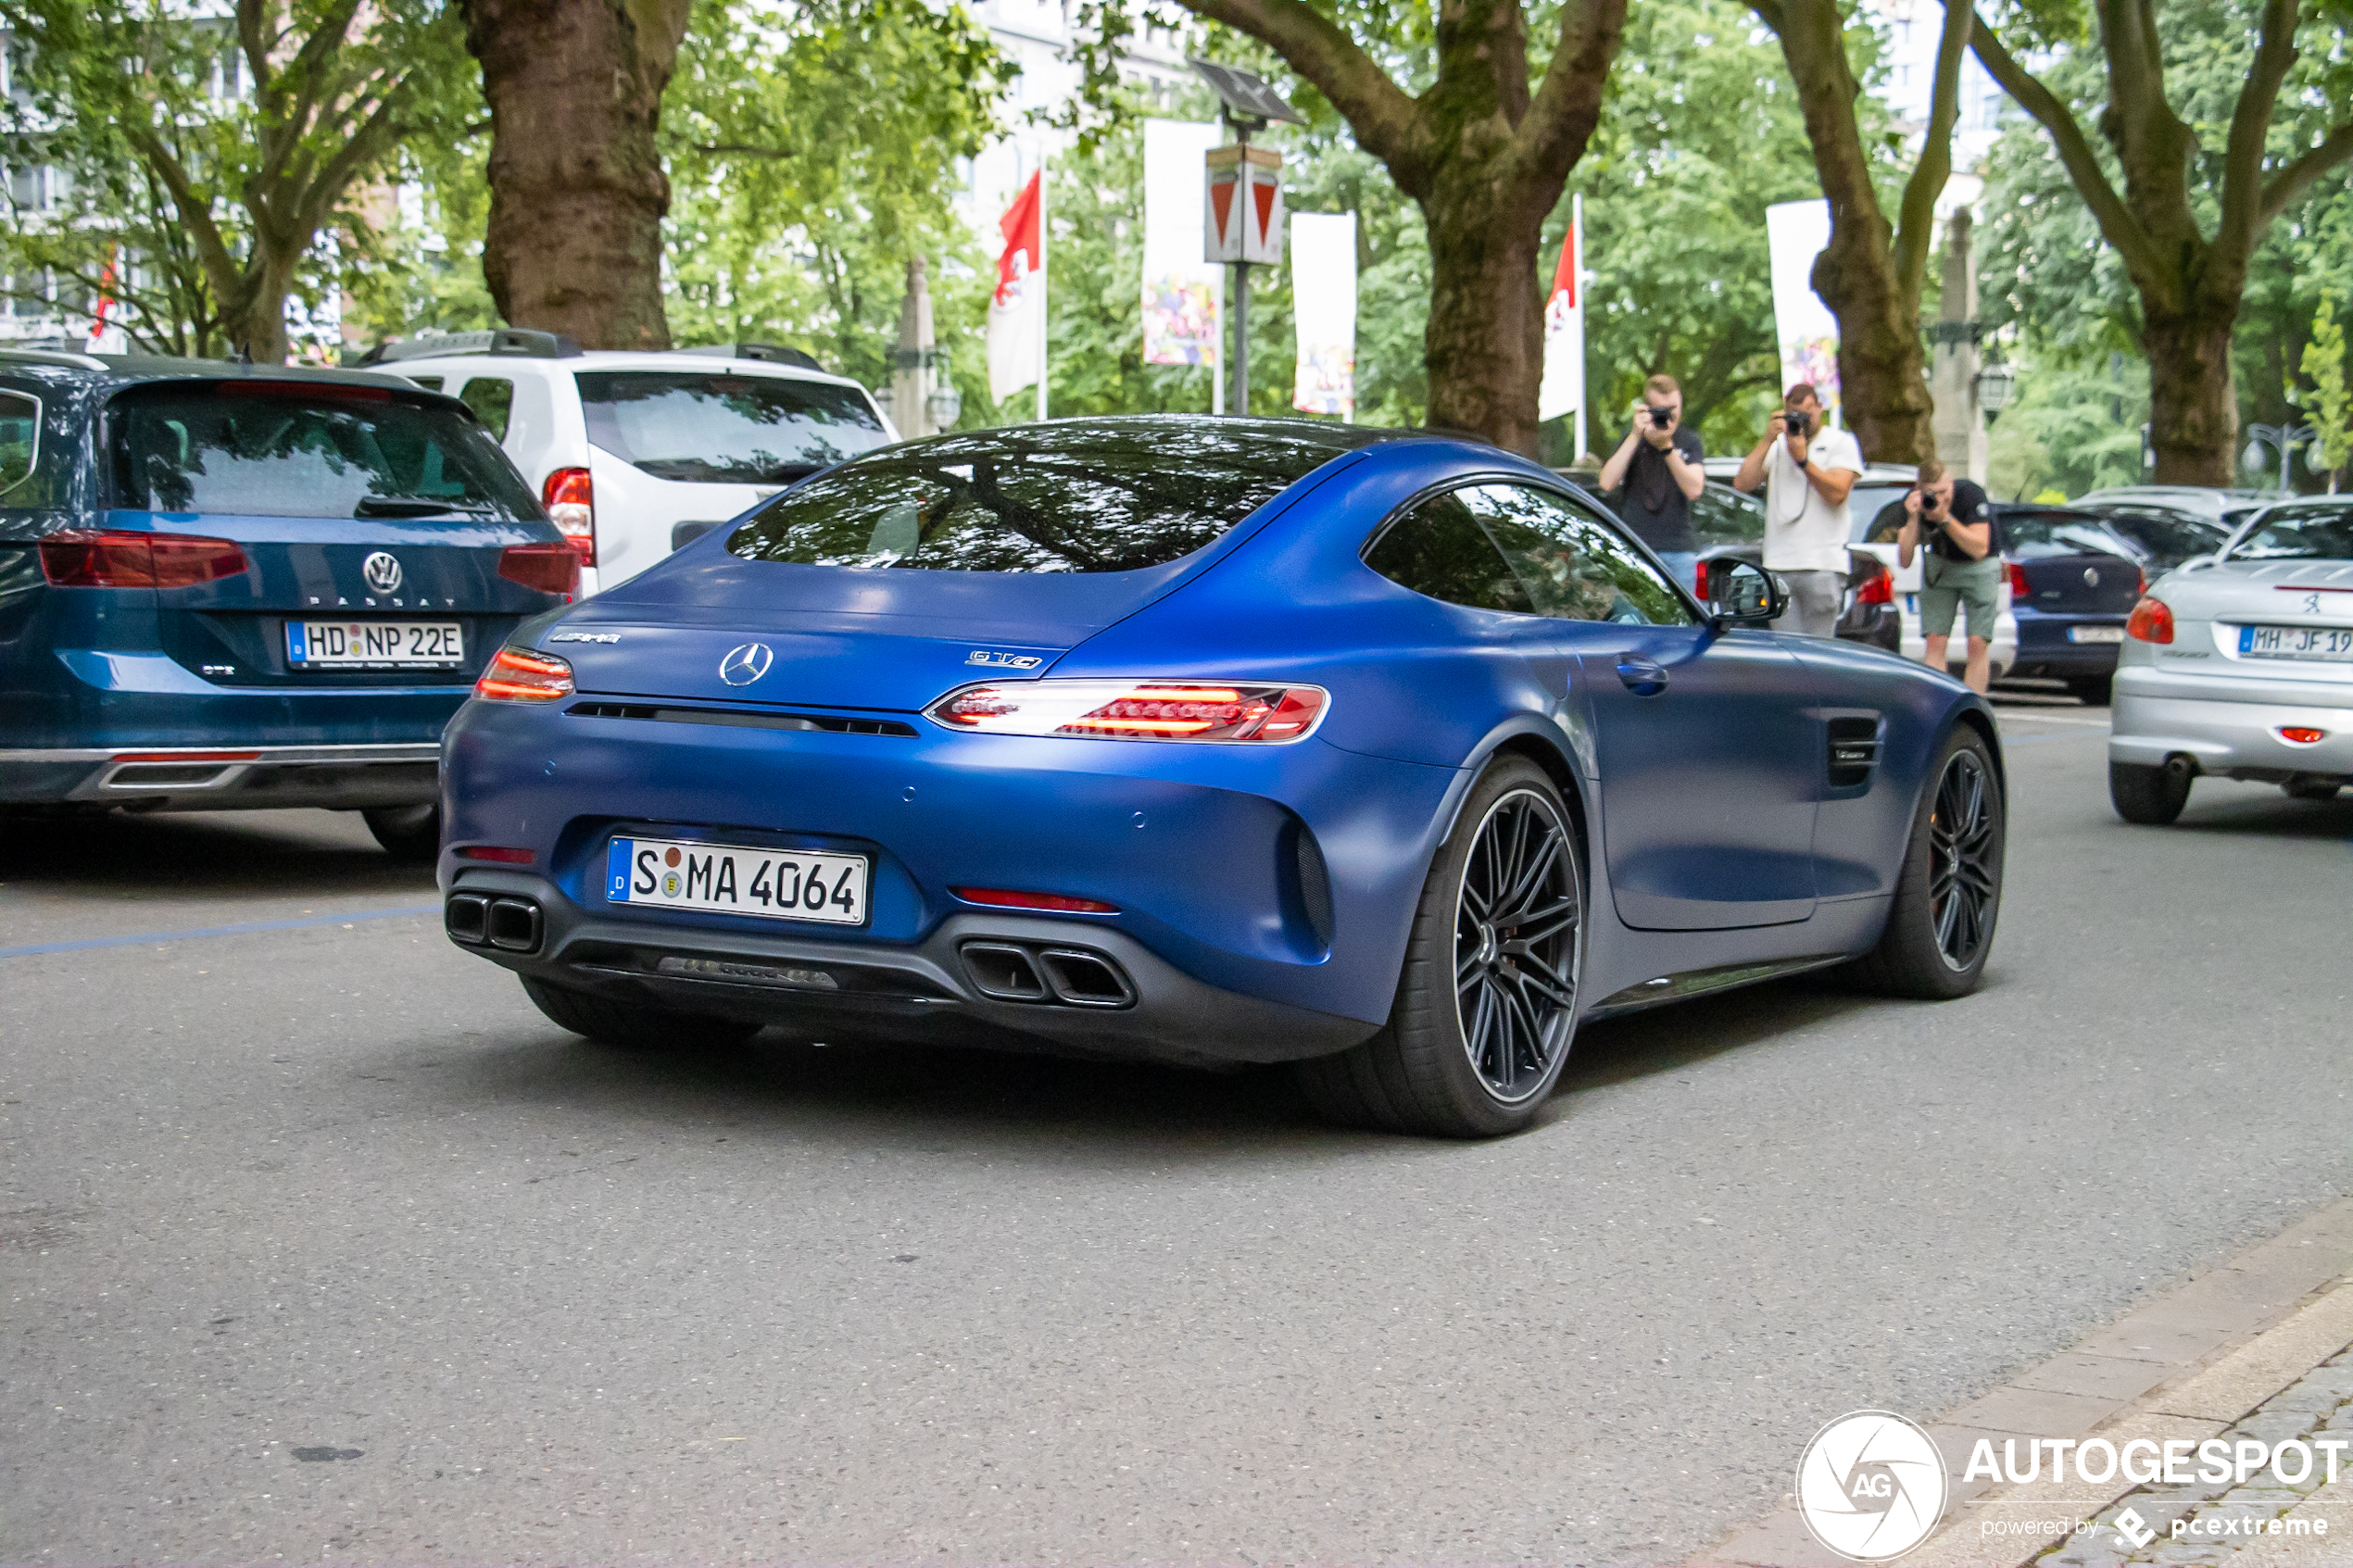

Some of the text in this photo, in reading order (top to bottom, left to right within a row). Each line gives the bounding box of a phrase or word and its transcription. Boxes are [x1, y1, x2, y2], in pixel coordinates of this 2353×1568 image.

[309, 596, 454, 608] PASSAT
[308, 627, 346, 656] HD
[366, 627, 400, 656] NP
[409, 628, 459, 656] 22E
[2255, 630, 2281, 649] MH
[2296, 630, 2323, 650] JF
[615, 850, 854, 914] D S MA 4064
